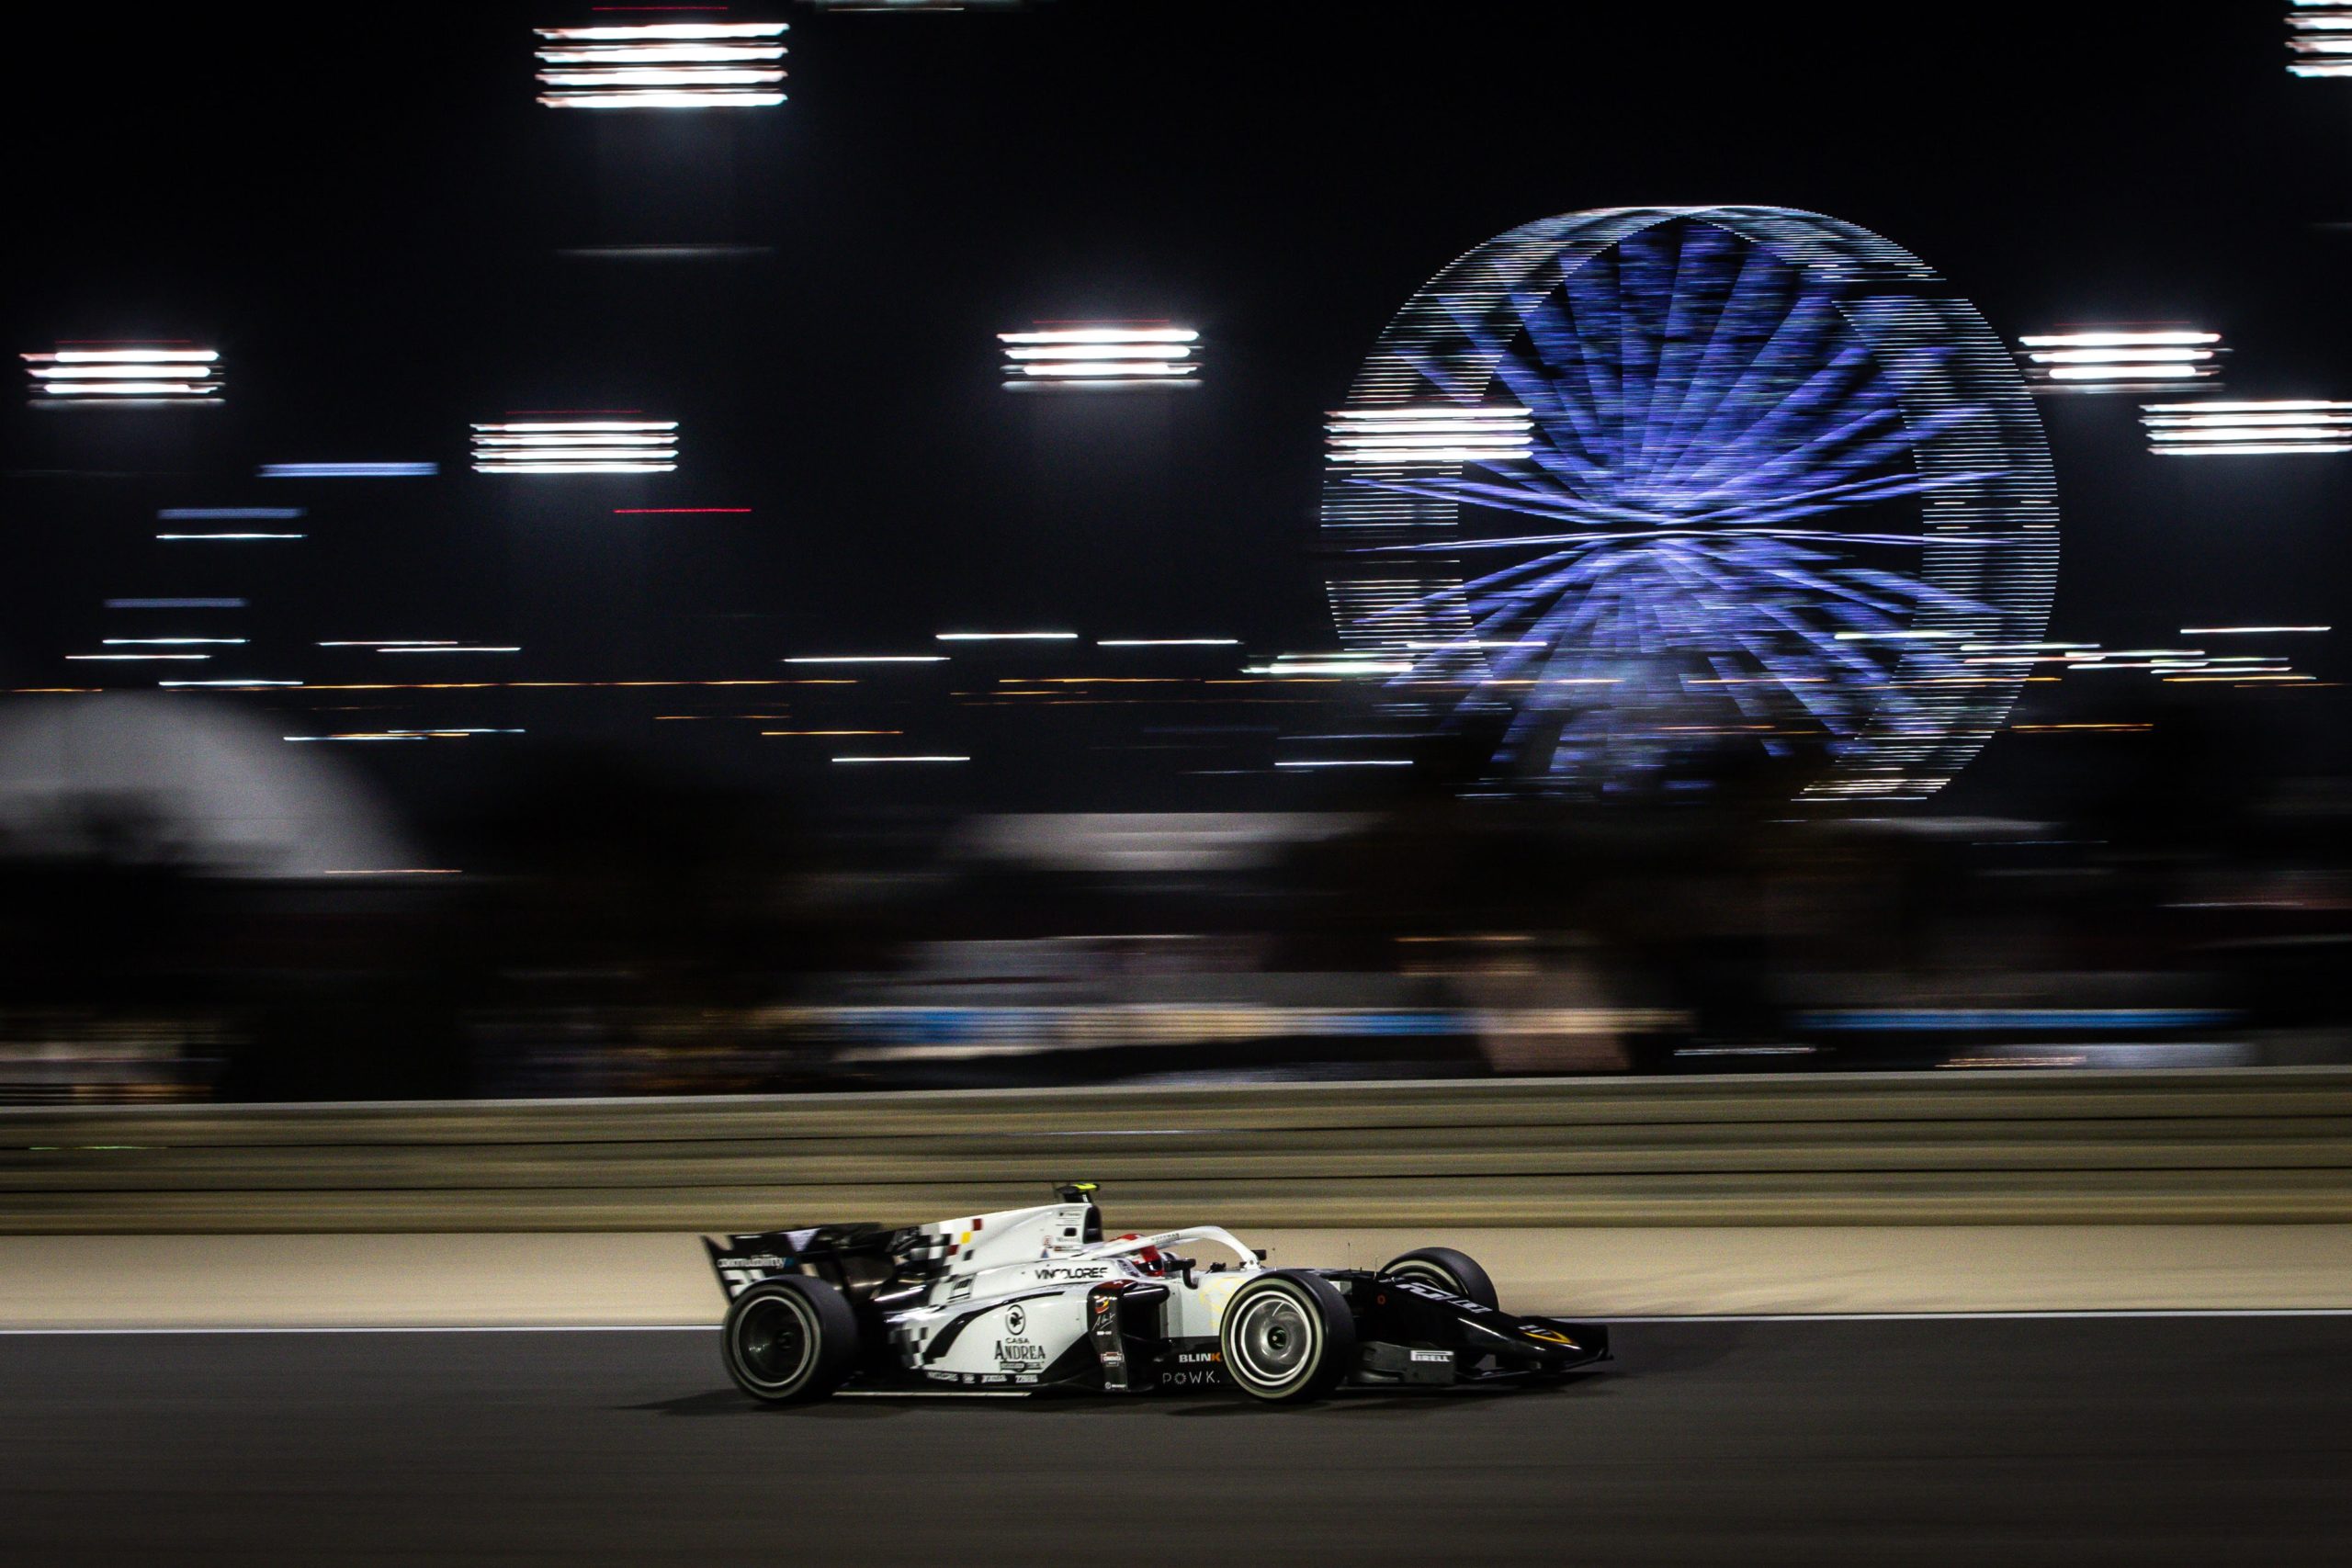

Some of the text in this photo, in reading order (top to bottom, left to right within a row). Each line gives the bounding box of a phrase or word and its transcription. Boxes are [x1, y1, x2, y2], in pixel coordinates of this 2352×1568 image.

[994, 1340, 1046, 1360] ANDREA
[1410, 1349, 1454, 1362] PIRELL
[1179, 1352, 1221, 1363] BLINK
